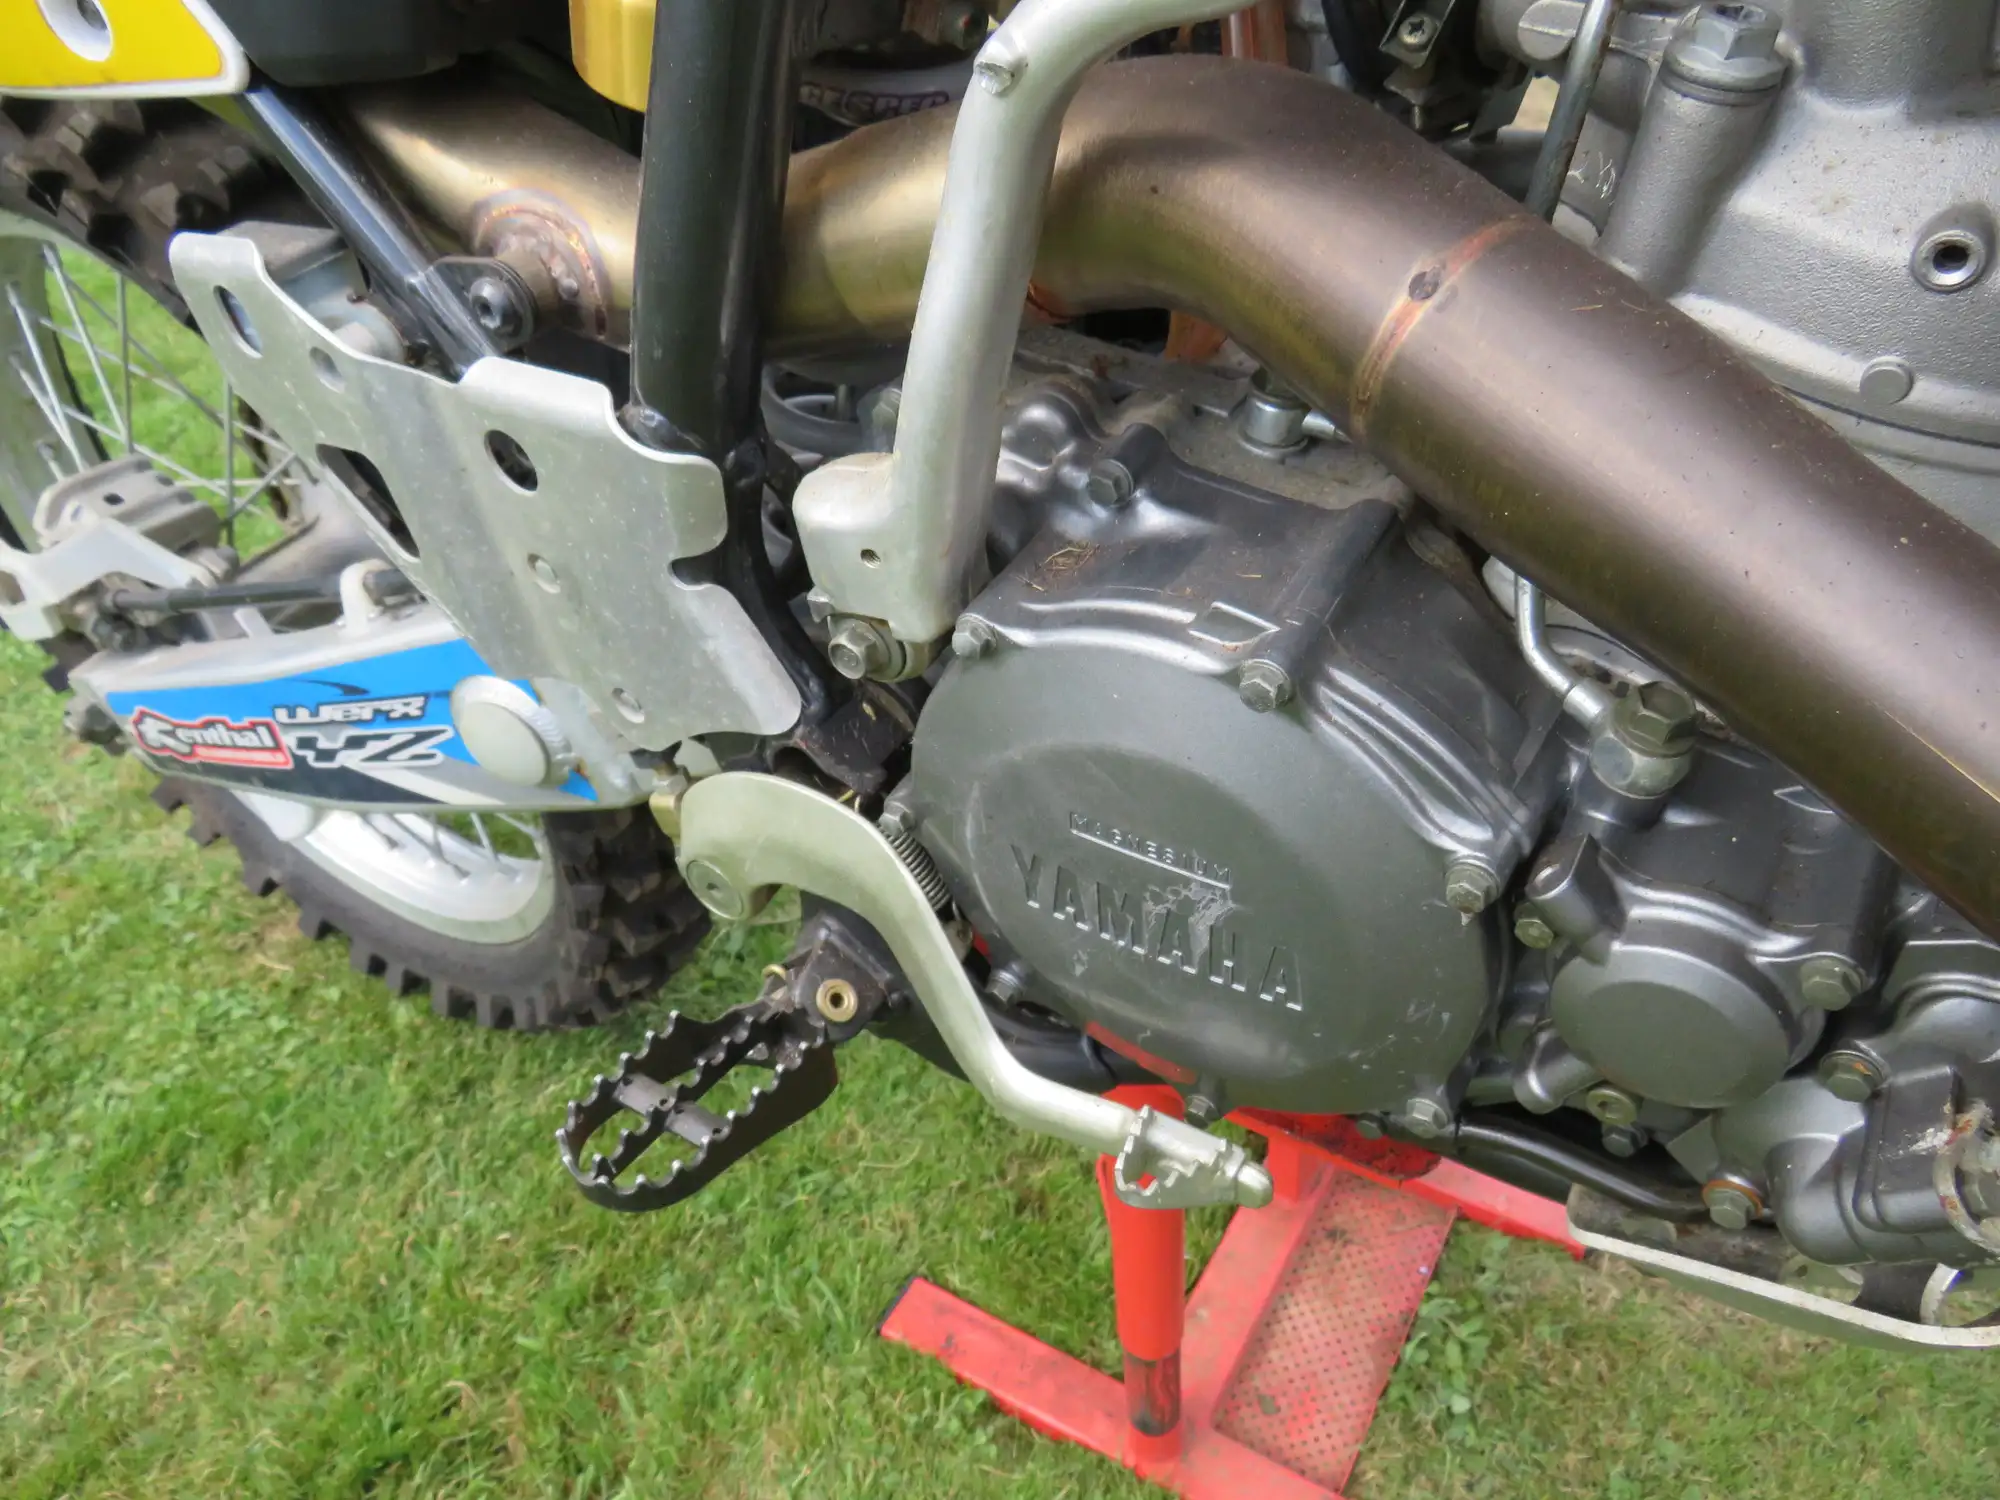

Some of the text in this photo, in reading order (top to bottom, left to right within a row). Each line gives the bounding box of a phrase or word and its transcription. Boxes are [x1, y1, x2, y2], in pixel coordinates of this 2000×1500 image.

[293, 726, 454, 767] YZ
[1069, 810, 1232, 889] MAGNESIUM
[1010, 843, 1304, 1012] YAMAHA
